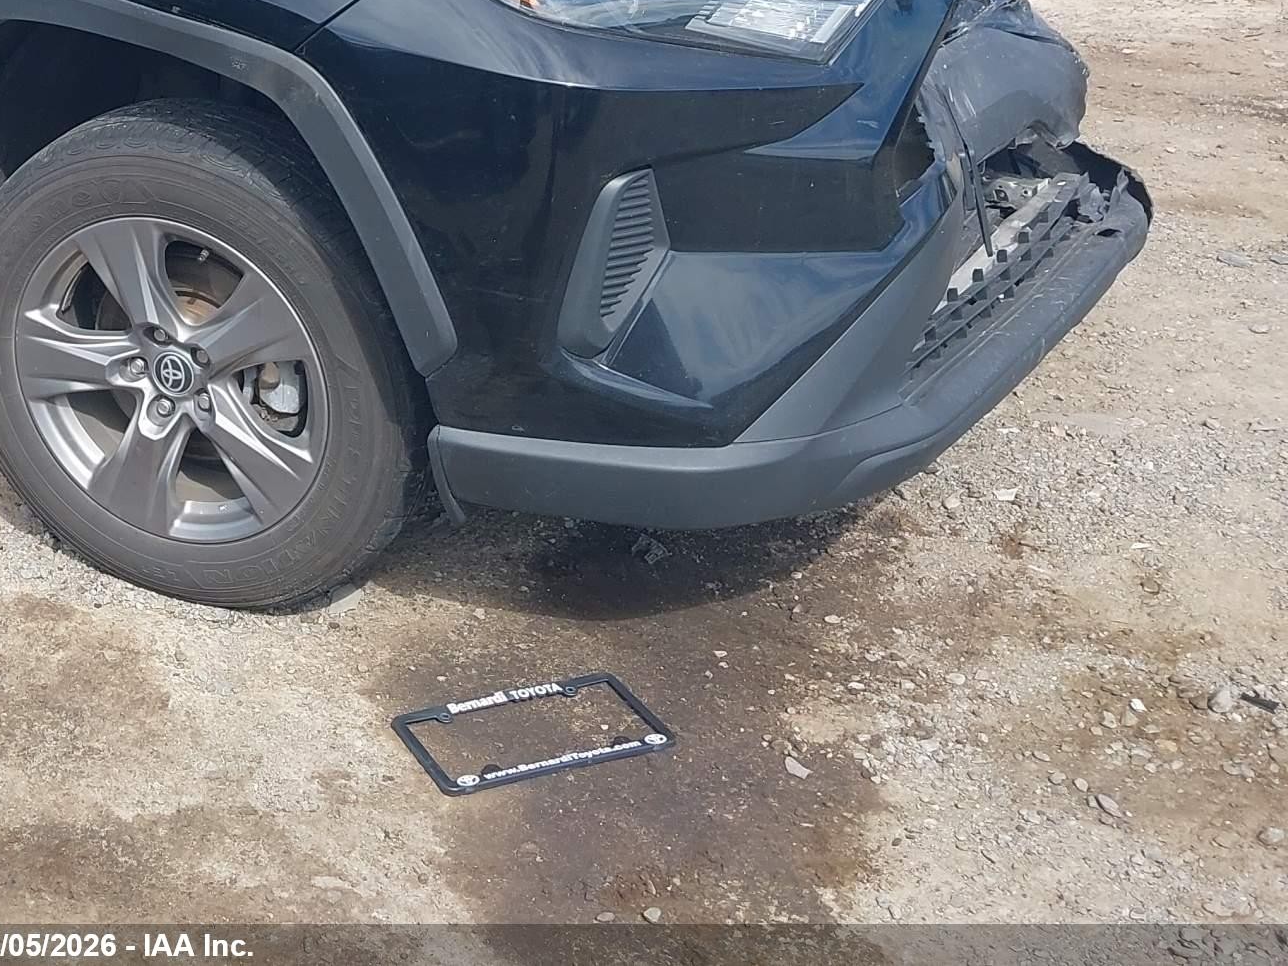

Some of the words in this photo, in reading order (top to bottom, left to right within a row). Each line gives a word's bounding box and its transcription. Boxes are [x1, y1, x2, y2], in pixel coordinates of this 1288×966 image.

[446, 690, 507, 715] Bernardi
[508, 682, 563, 702] TOYOTA
[483, 739, 642, 781] www.BernardiToyota.com
